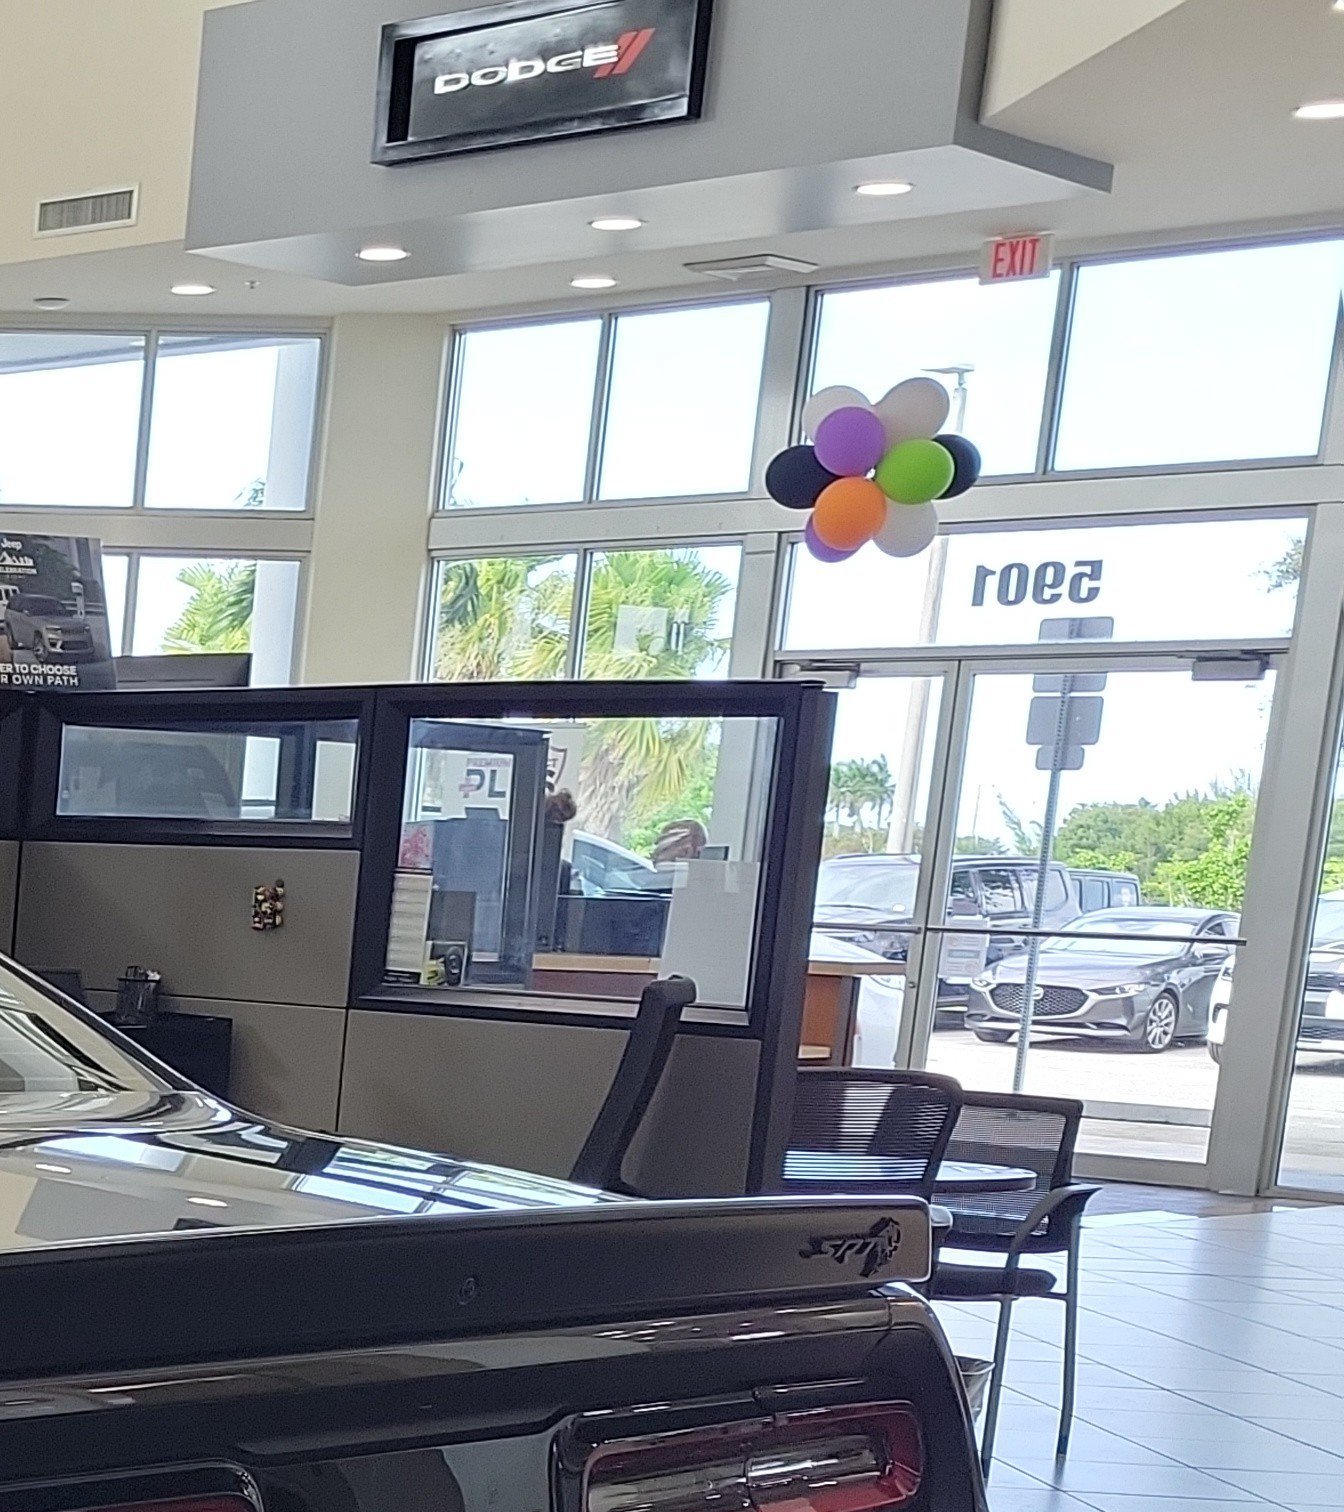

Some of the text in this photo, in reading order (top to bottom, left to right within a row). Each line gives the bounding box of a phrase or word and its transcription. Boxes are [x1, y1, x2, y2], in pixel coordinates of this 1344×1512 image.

[433, 44, 620, 94] DODGE
[992, 238, 1041, 278] EXIT
[12, 675, 44, 686] OWN
[47, 675, 80, 687] PATH
[14, 663, 29, 674] TO
[30, 664, 78, 676] CHOOSE
